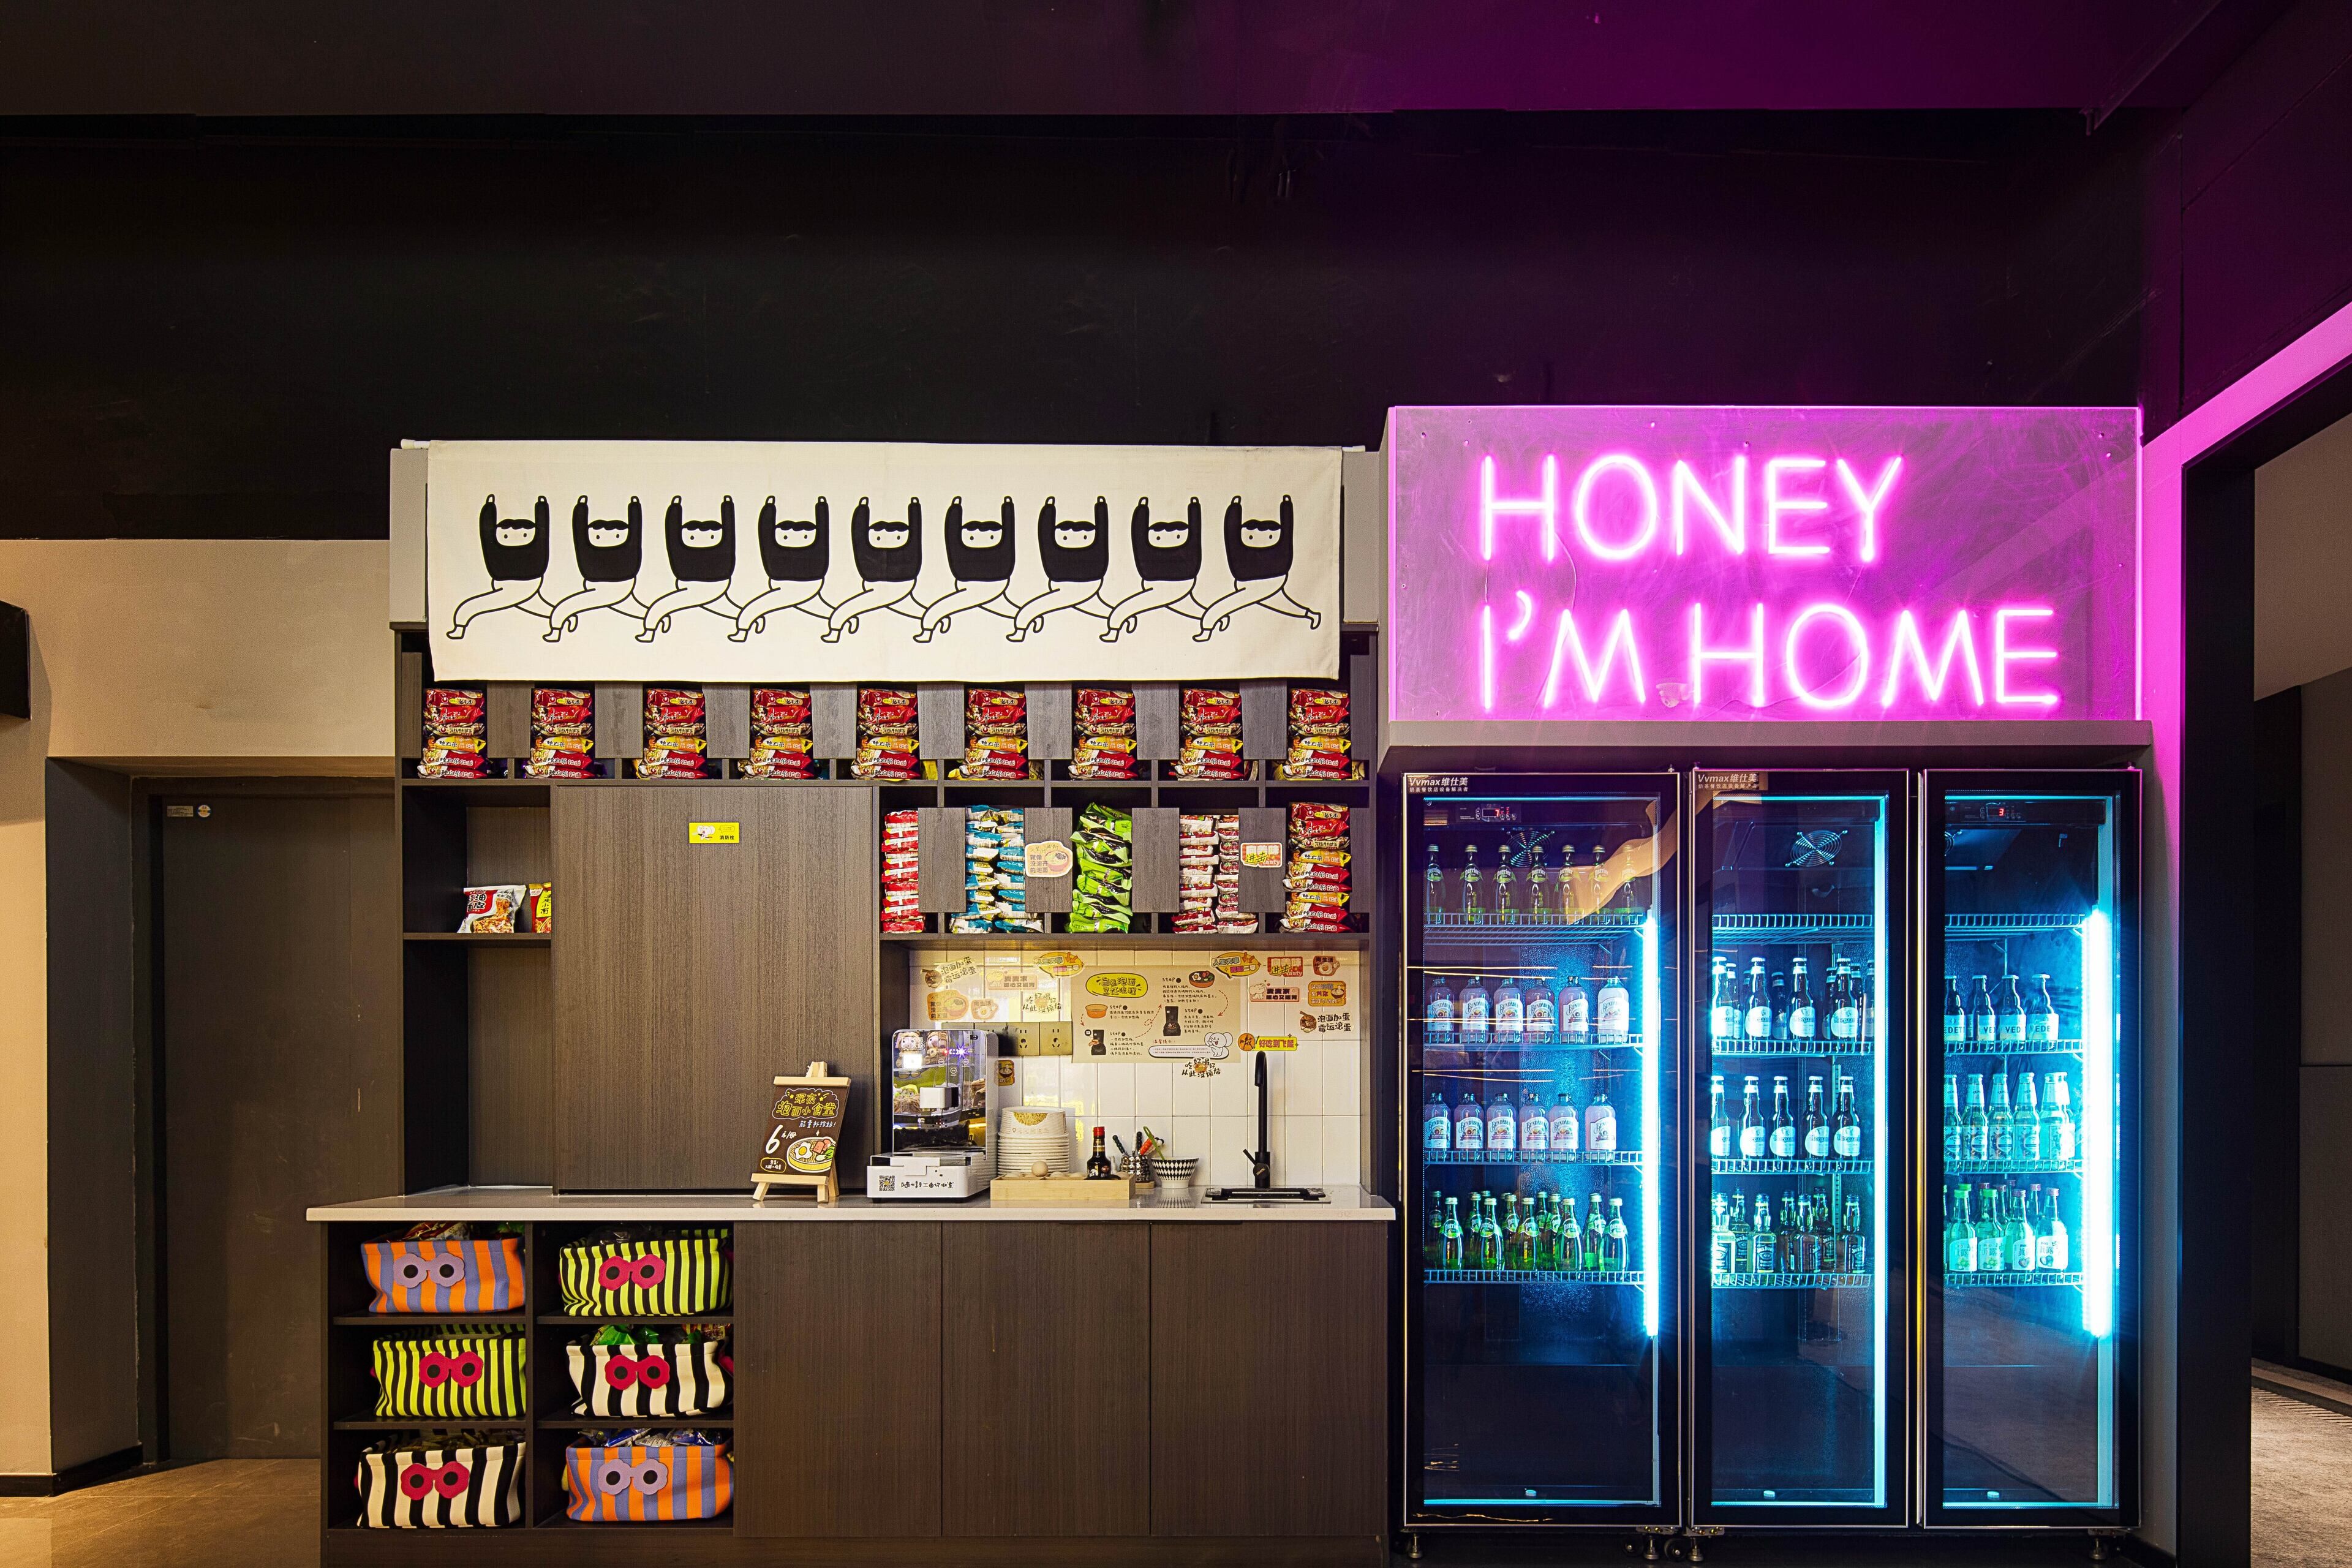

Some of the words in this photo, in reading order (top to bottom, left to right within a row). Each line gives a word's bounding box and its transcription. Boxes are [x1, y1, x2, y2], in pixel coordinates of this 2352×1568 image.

[1479, 452, 1902, 562] HONEY
[1692, 601, 2058, 710] HOME
[1409, 777, 1441, 786] Vvmax
[1441, 777, 1468, 786] 维仕美
[1698, 774, 1729, 782] Vvmax
[1730, 774, 1757, 782] 维仕美
[1495, 809, 1500, 817] 7
[1246, 852, 1267, 864] 进击
[1213, 957, 1240, 966] 人生大事
[1271, 965, 1291, 975] 进击
[1317, 1012, 1351, 1022] 泡面加蛋
[1259, 1039, 1294, 1048] 好吃到飞起
[1182, 1068, 1221, 1079] 从此没烦恼
[794, 1093, 818, 1104] 深夜
[776, 1101, 837, 1117] 泡面小食堂
[765, 1125, 783, 1155] 6
